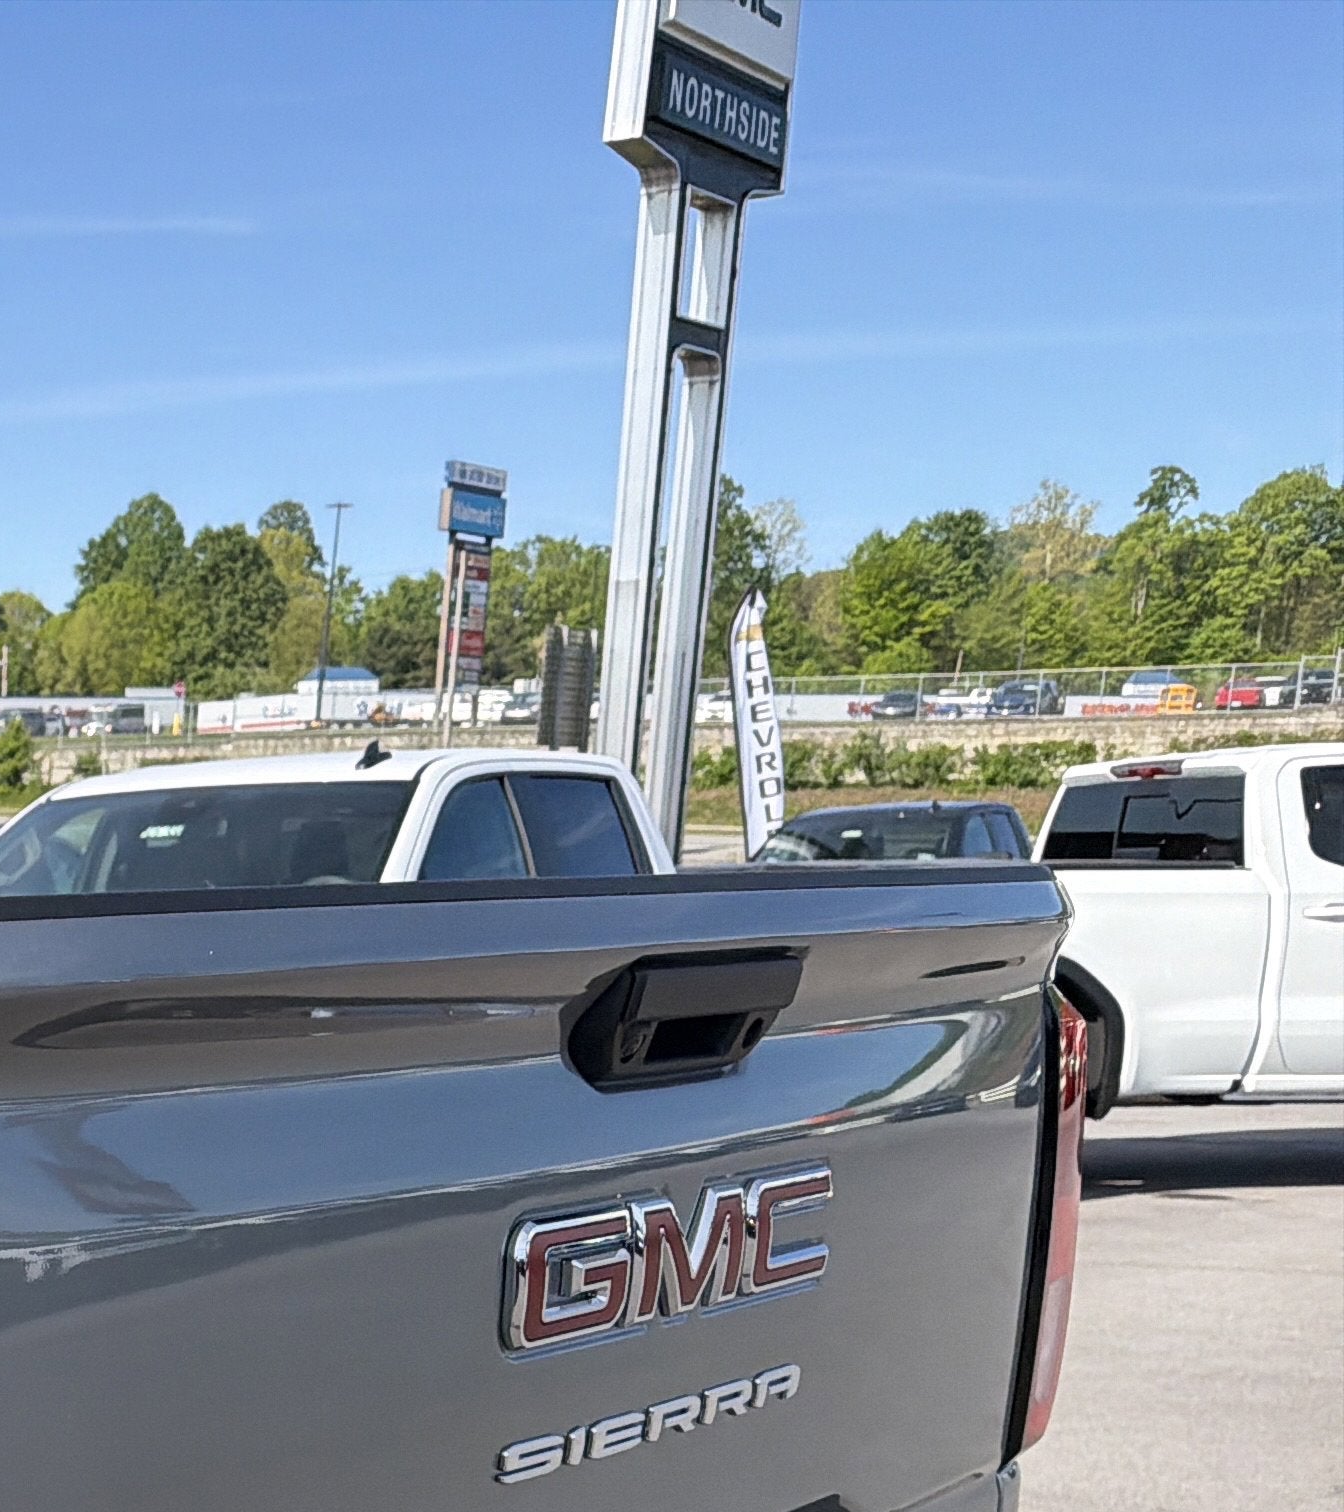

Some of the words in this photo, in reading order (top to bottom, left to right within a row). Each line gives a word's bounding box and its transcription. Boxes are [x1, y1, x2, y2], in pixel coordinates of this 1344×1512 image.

[668, 68, 782, 155] NORTHSIDE
[507, 1166, 833, 1350] GMC
[495, 1363, 801, 1484] SIERRA
